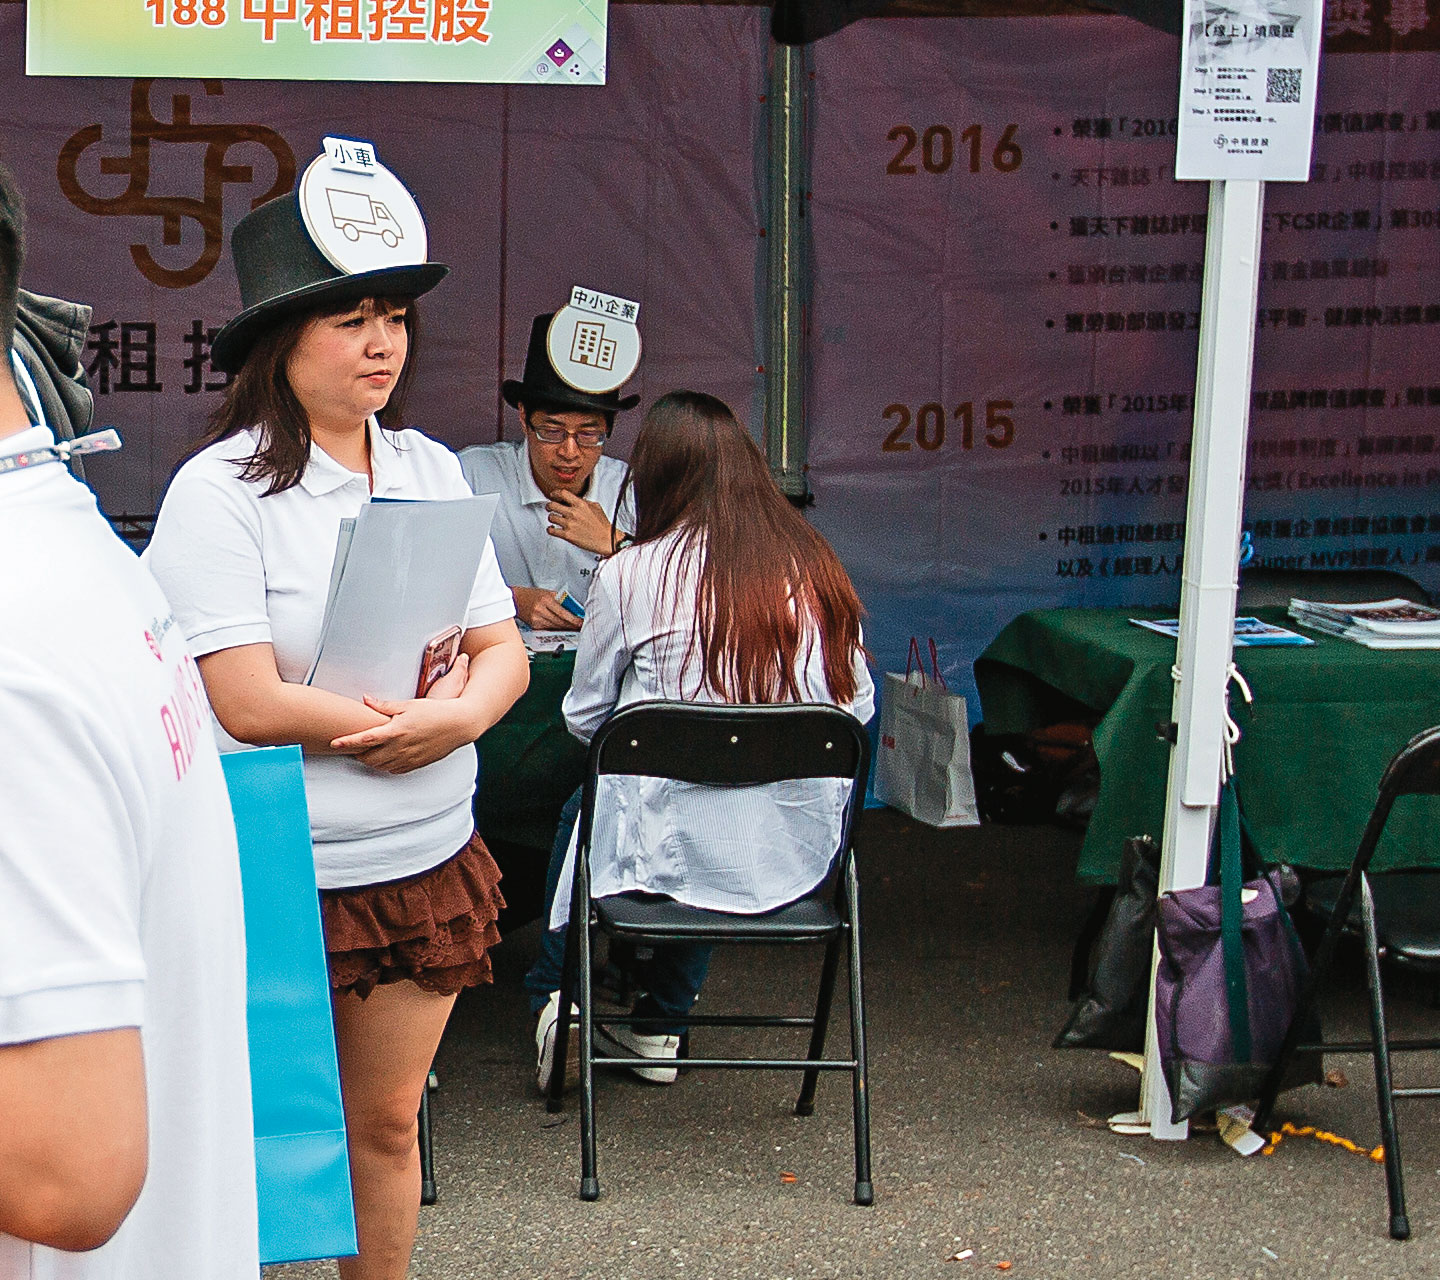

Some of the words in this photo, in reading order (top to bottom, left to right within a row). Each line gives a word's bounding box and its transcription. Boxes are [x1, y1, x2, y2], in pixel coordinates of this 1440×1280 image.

[334, 144, 374, 168] 小車
[885, 123, 1023, 176] 2016
[573, 289, 636, 320] 中小企業
[882, 400, 1017, 452] 2015
